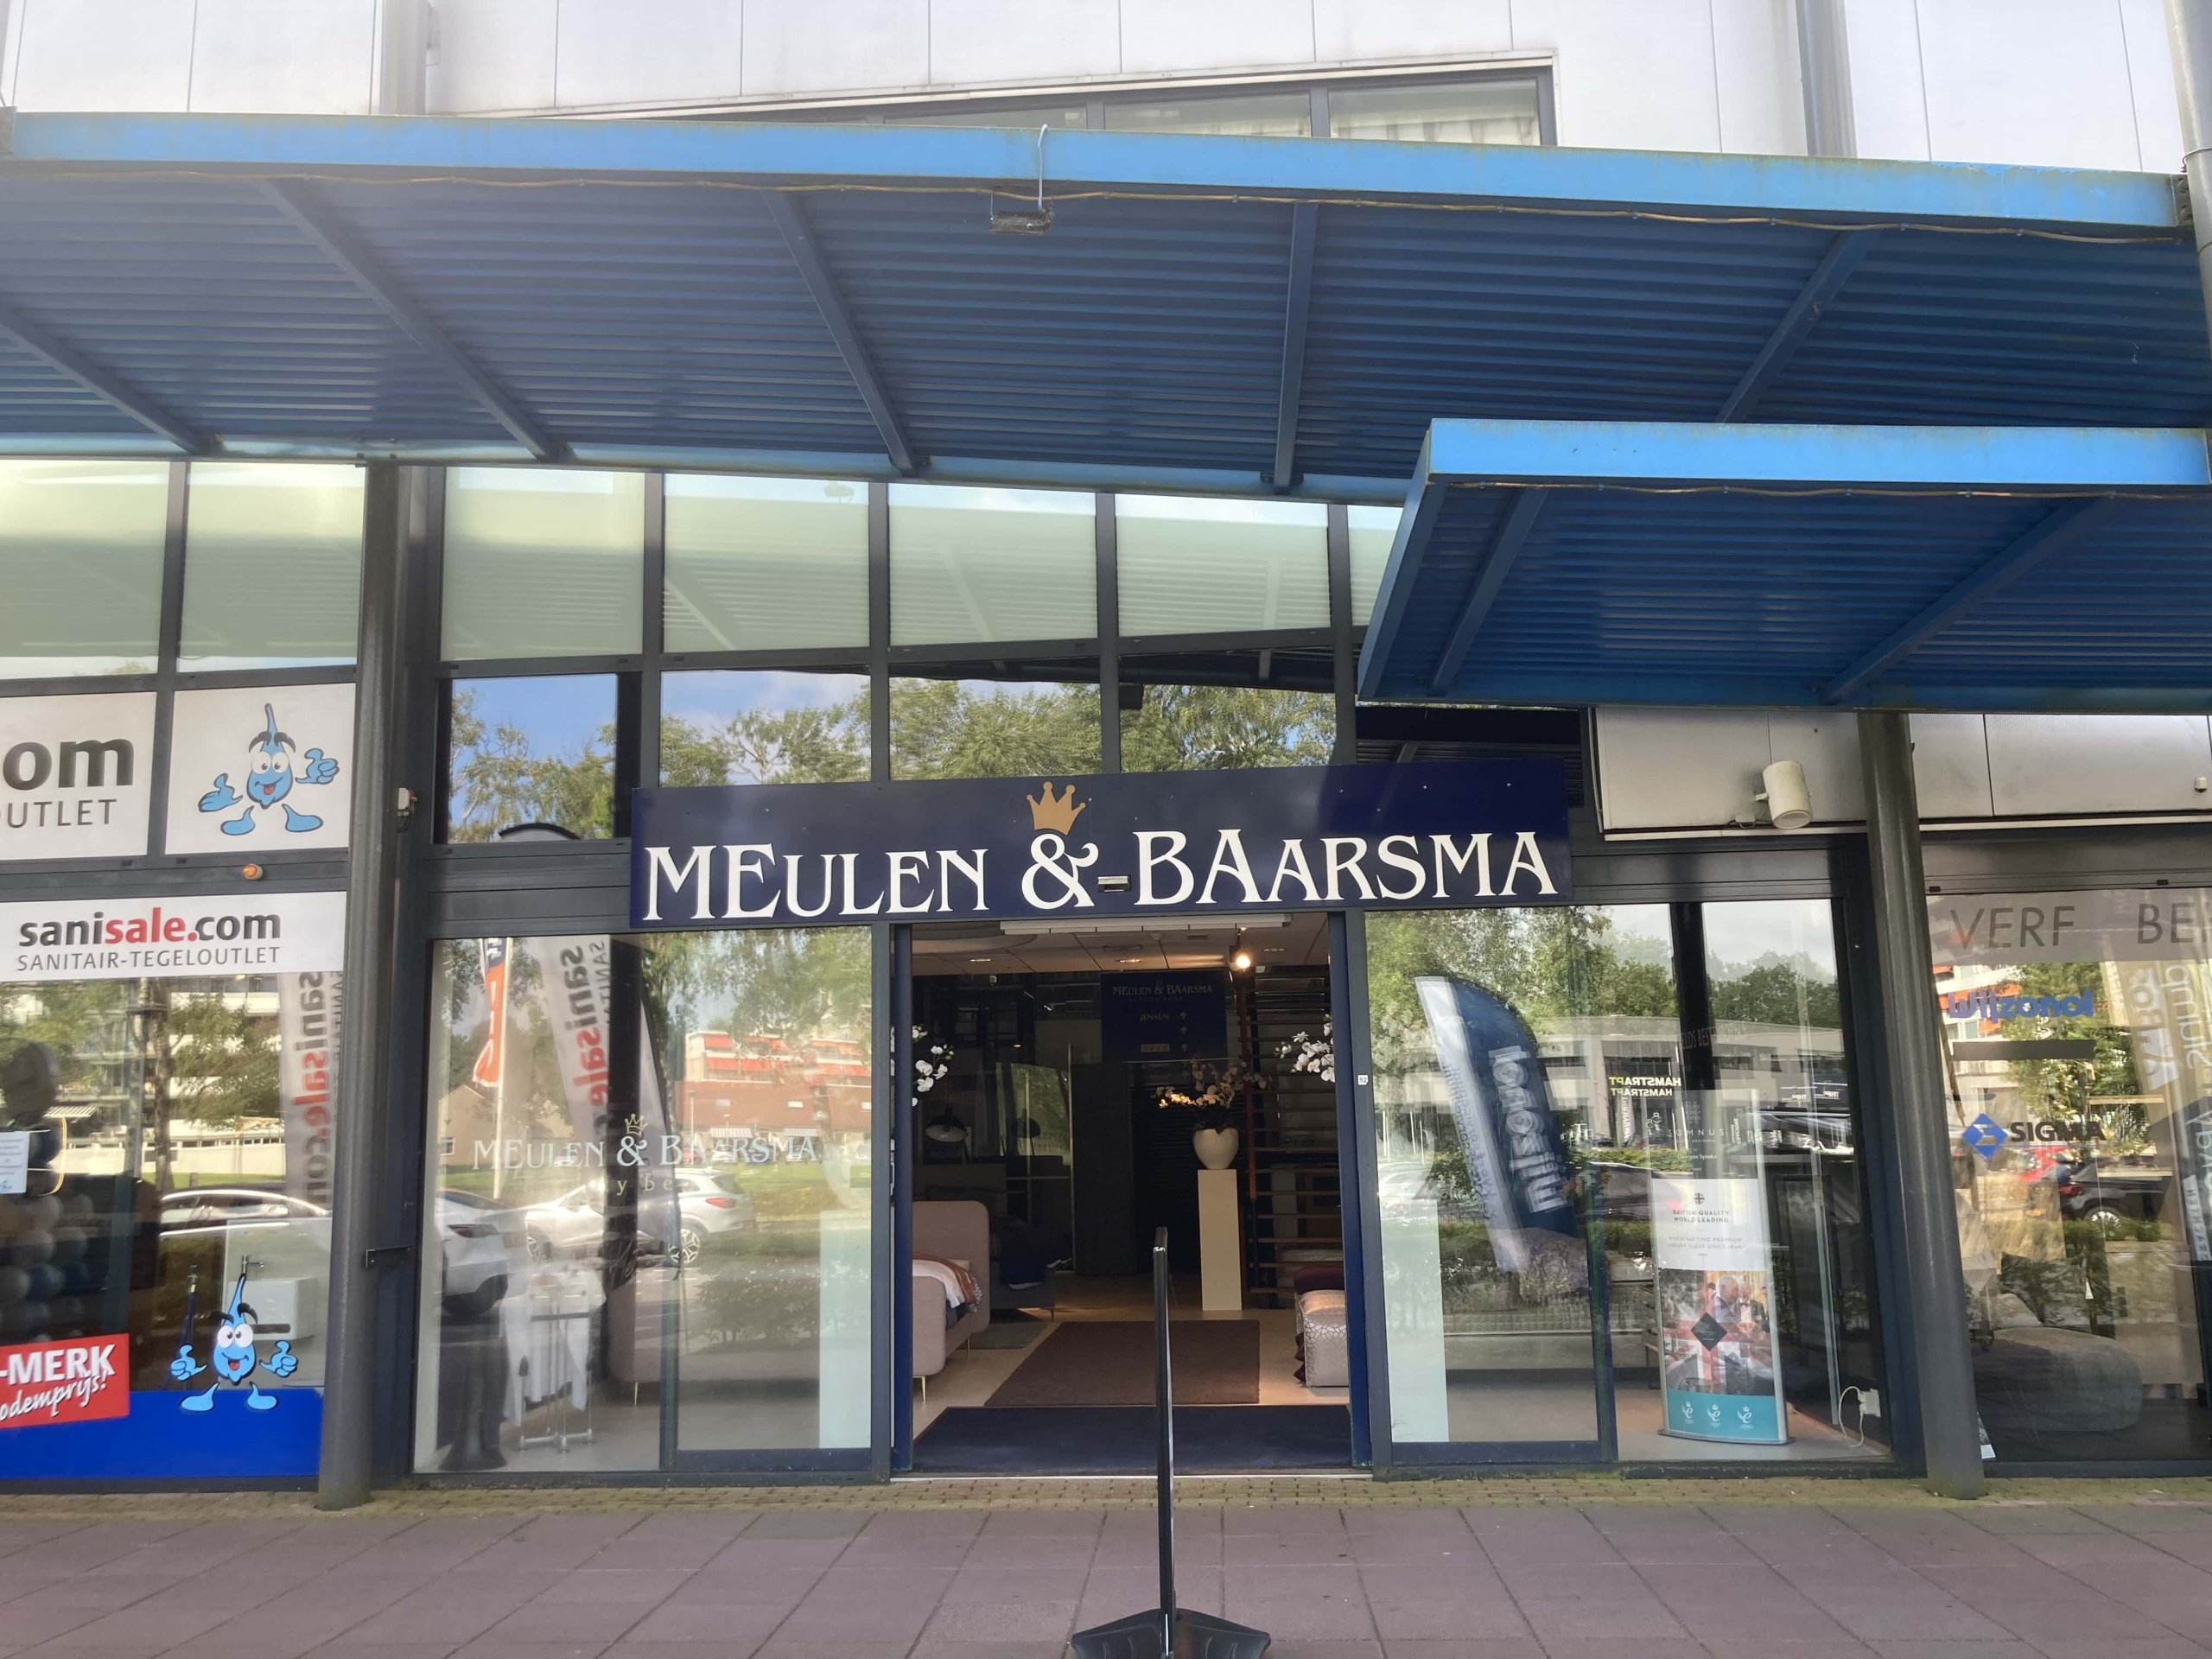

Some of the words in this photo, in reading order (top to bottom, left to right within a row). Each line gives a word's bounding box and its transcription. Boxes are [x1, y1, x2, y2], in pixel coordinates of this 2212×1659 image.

[0, 798, 117, 829] UTLET
[644, 842, 988, 922] MEULEN
[1020, 832, 1098, 910] &
[1133, 828, 1560, 906] BAARSMA
[19, 906, 281, 947] sanisale.com
[1949, 906, 2075, 950] VERF
[17, 946, 280, 972] SANITAIR-TEGELOUTLET
[1112, 986, 1152, 995] MEULEN
[1166, 984, 1213, 995] BAARSMA
[1948, 989, 2094, 1024] Wijzonol
[1668, 1128, 1725, 1138] SOMNUS
[2010, 1121, 2106, 1142] SIGMA
[472, 1139, 606, 1171] MEULEN
[616, 1135, 648, 1167] &
[659, 1135, 818, 1166] BAARSMA
